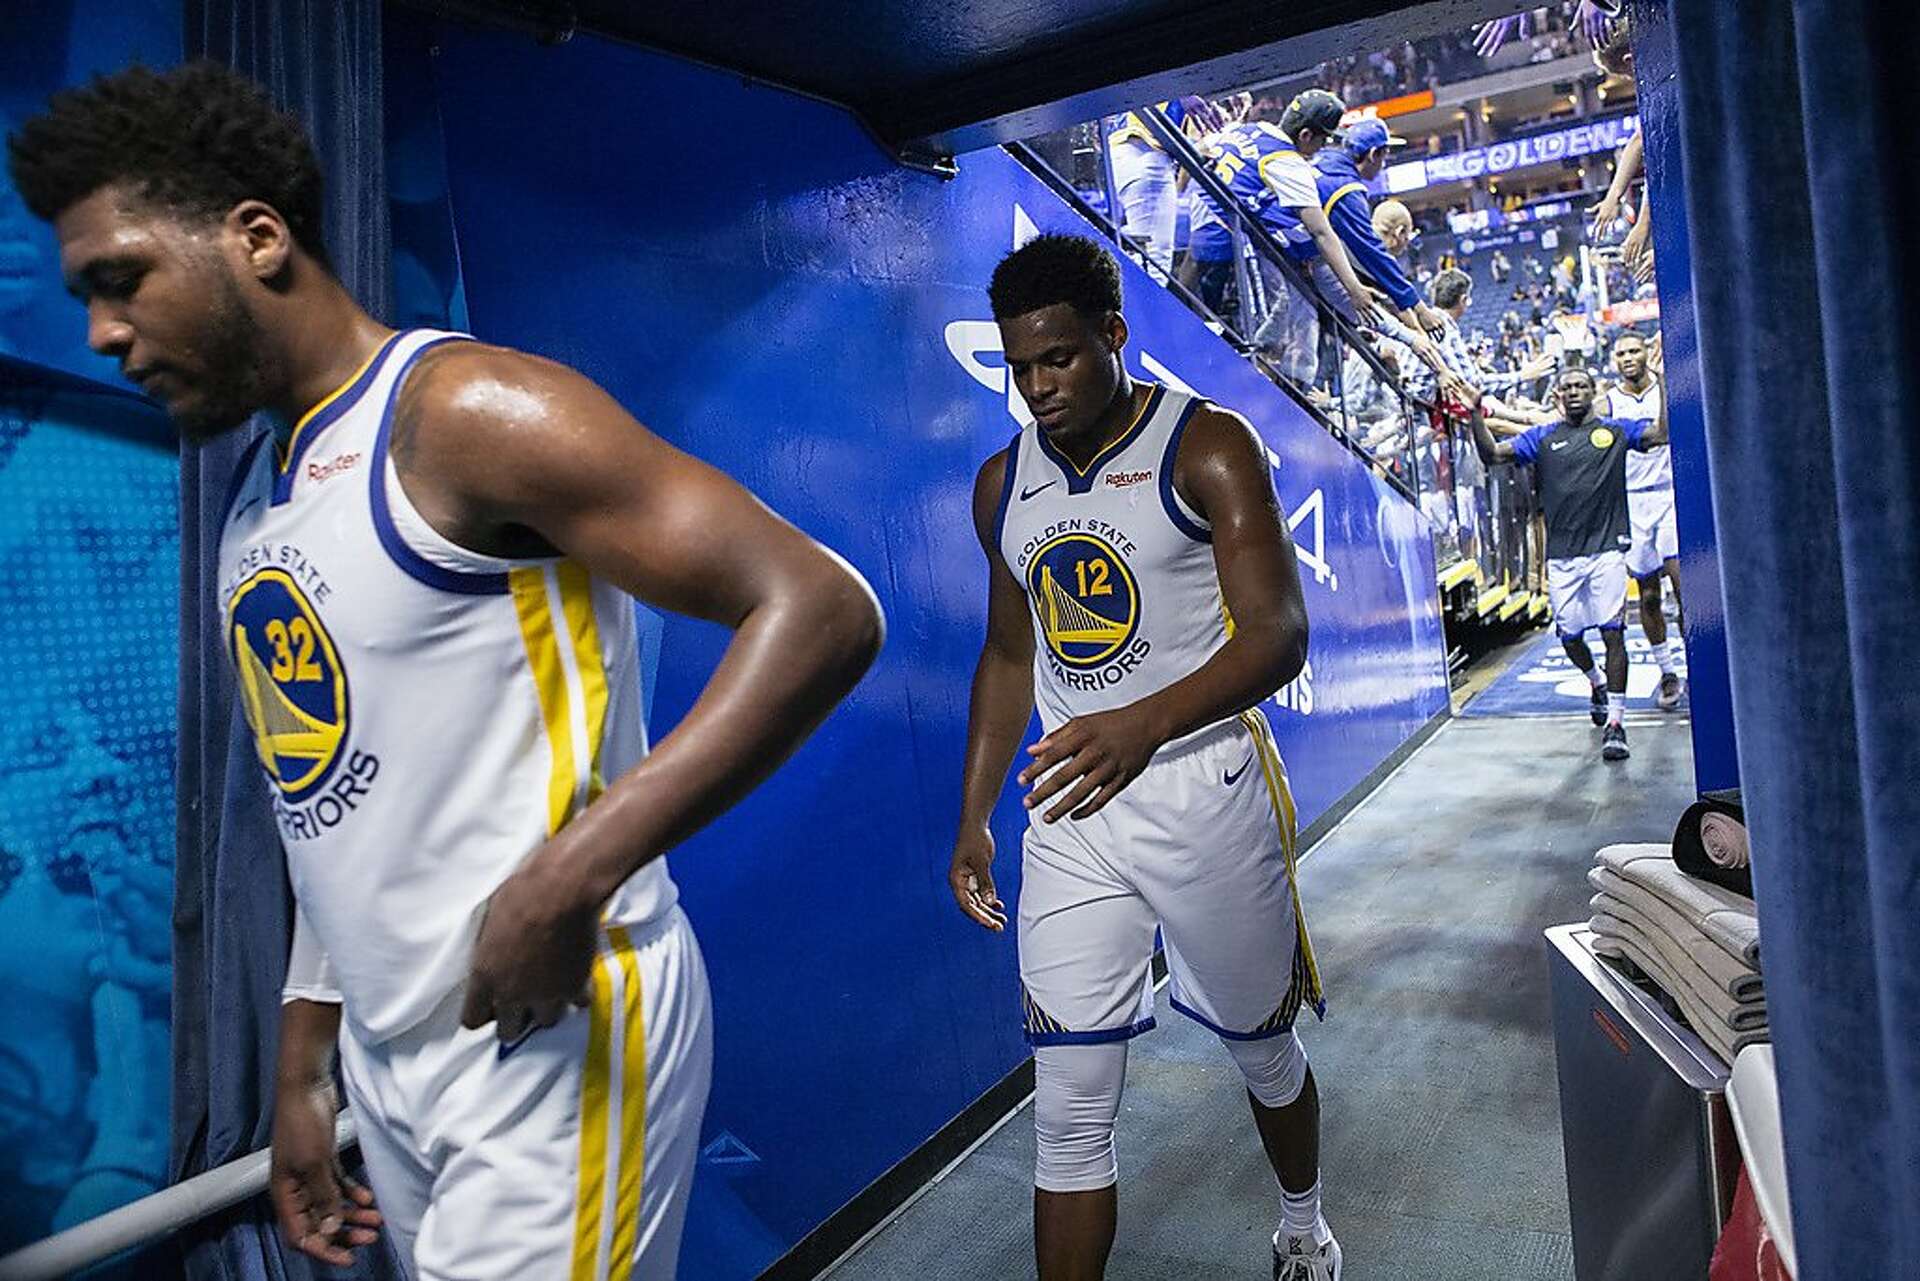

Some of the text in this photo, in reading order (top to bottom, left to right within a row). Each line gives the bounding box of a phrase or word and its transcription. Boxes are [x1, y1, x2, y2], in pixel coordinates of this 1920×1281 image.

[1458, 120, 1617, 177] GOLDEN
[1106, 470, 1152, 488] Rakuten
[1018, 519, 1137, 567] GOLDEN STATE
[280, 545, 331, 605] STATE
[1076, 558, 1112, 597] 12
[264, 616, 322, 682] 32
[279, 750, 379, 840] RIORS
